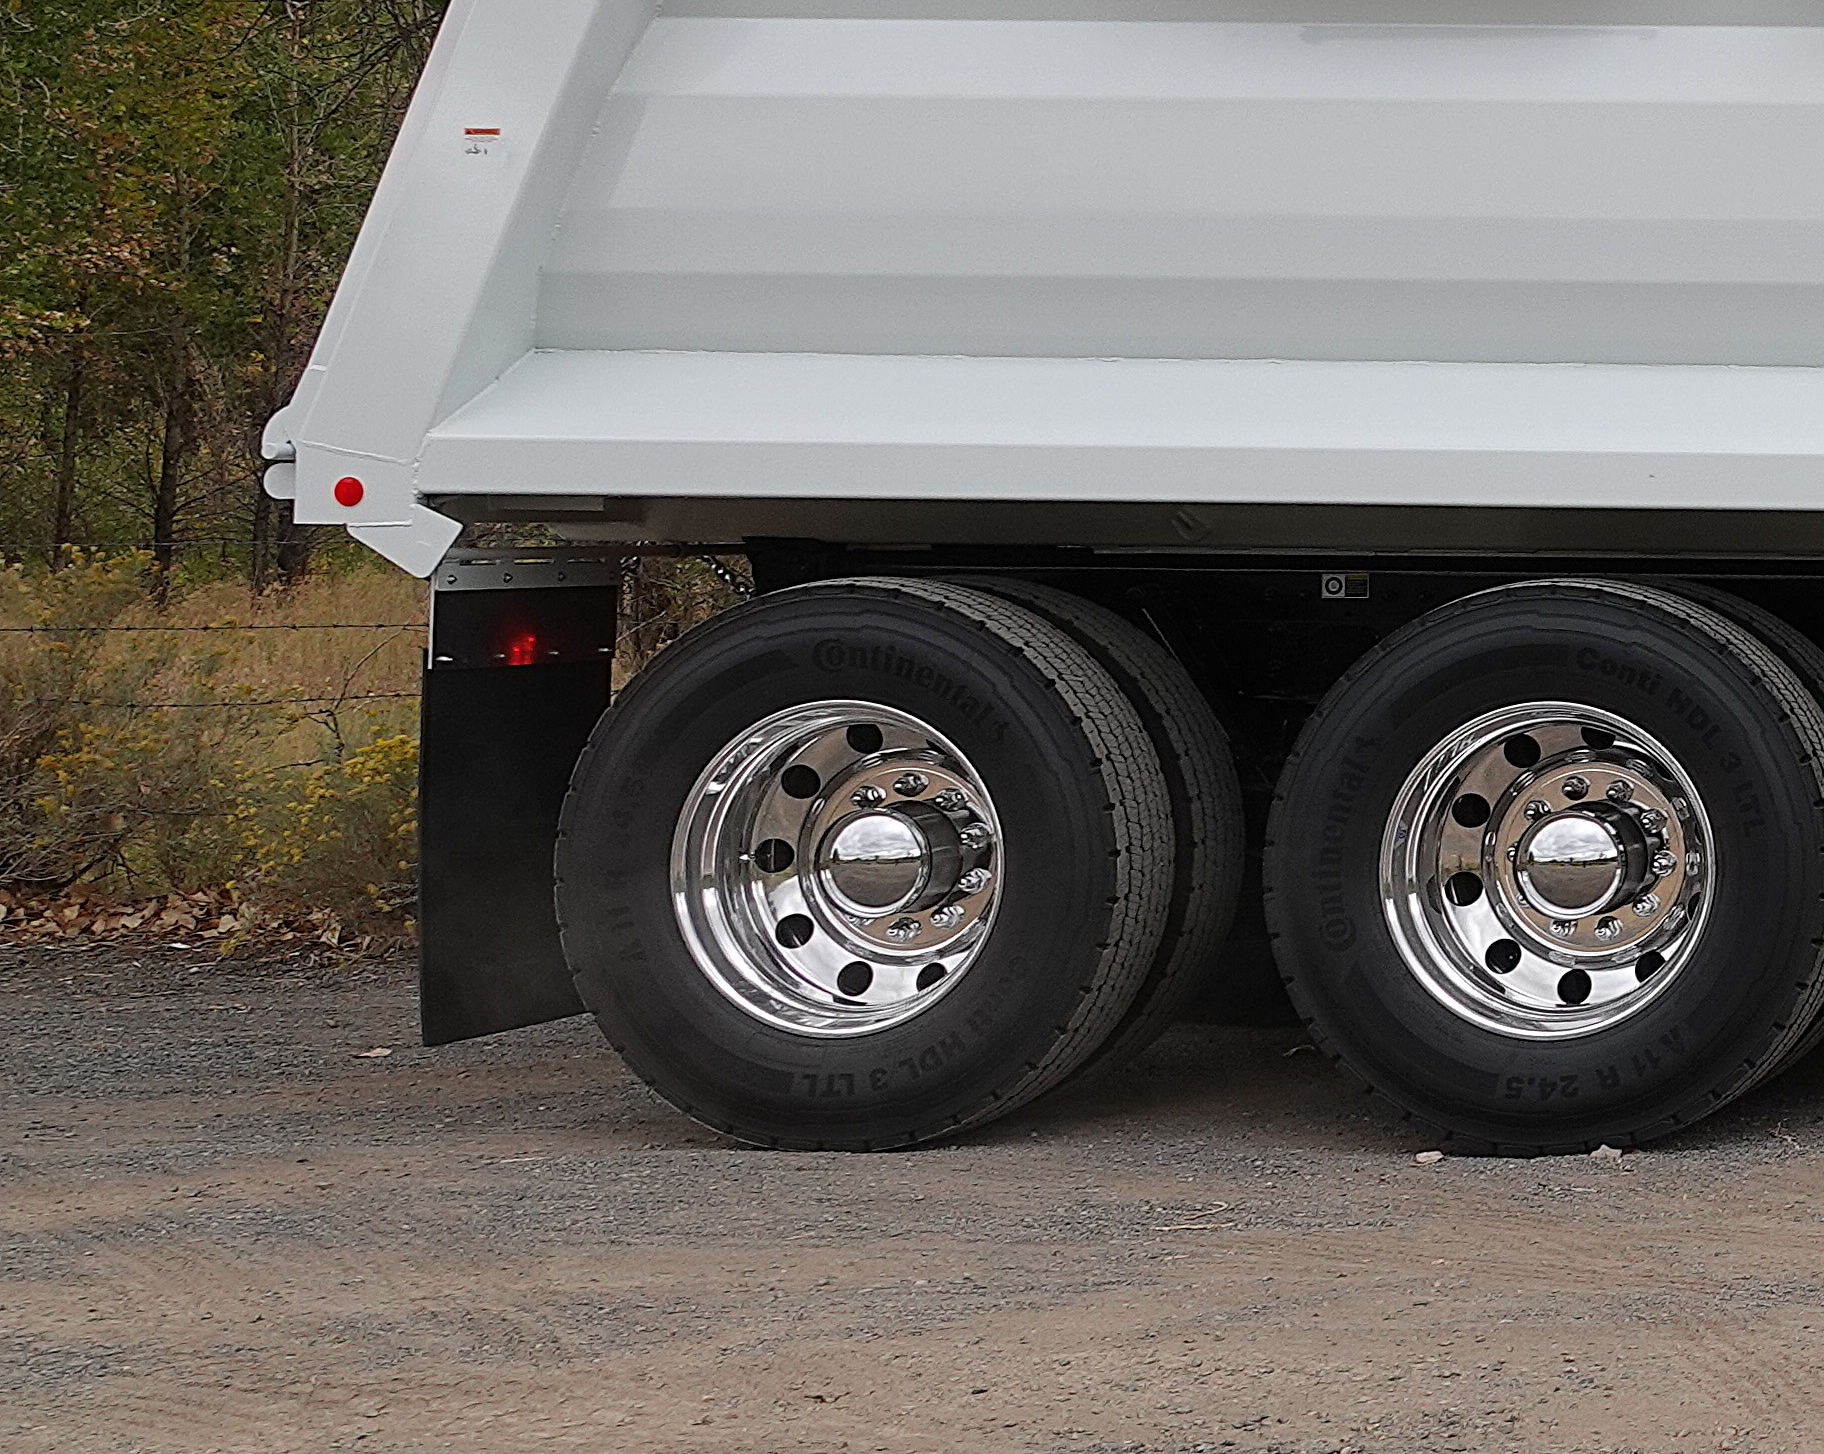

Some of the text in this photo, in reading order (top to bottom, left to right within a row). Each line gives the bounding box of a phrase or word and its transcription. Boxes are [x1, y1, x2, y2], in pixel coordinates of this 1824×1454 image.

[807, 636, 1000, 728] Continental
[1574, 644, 1768, 837] Conti HDL 3 LTL
[1311, 753, 1371, 957] Continental
[895, 1029, 969, 1083] HDL
[798, 1069, 856, 1099] LTL
[867, 1066, 891, 1092] 3
[1502, 1071, 1581, 1103] 24.5
[1594, 1063, 1622, 1093] R
